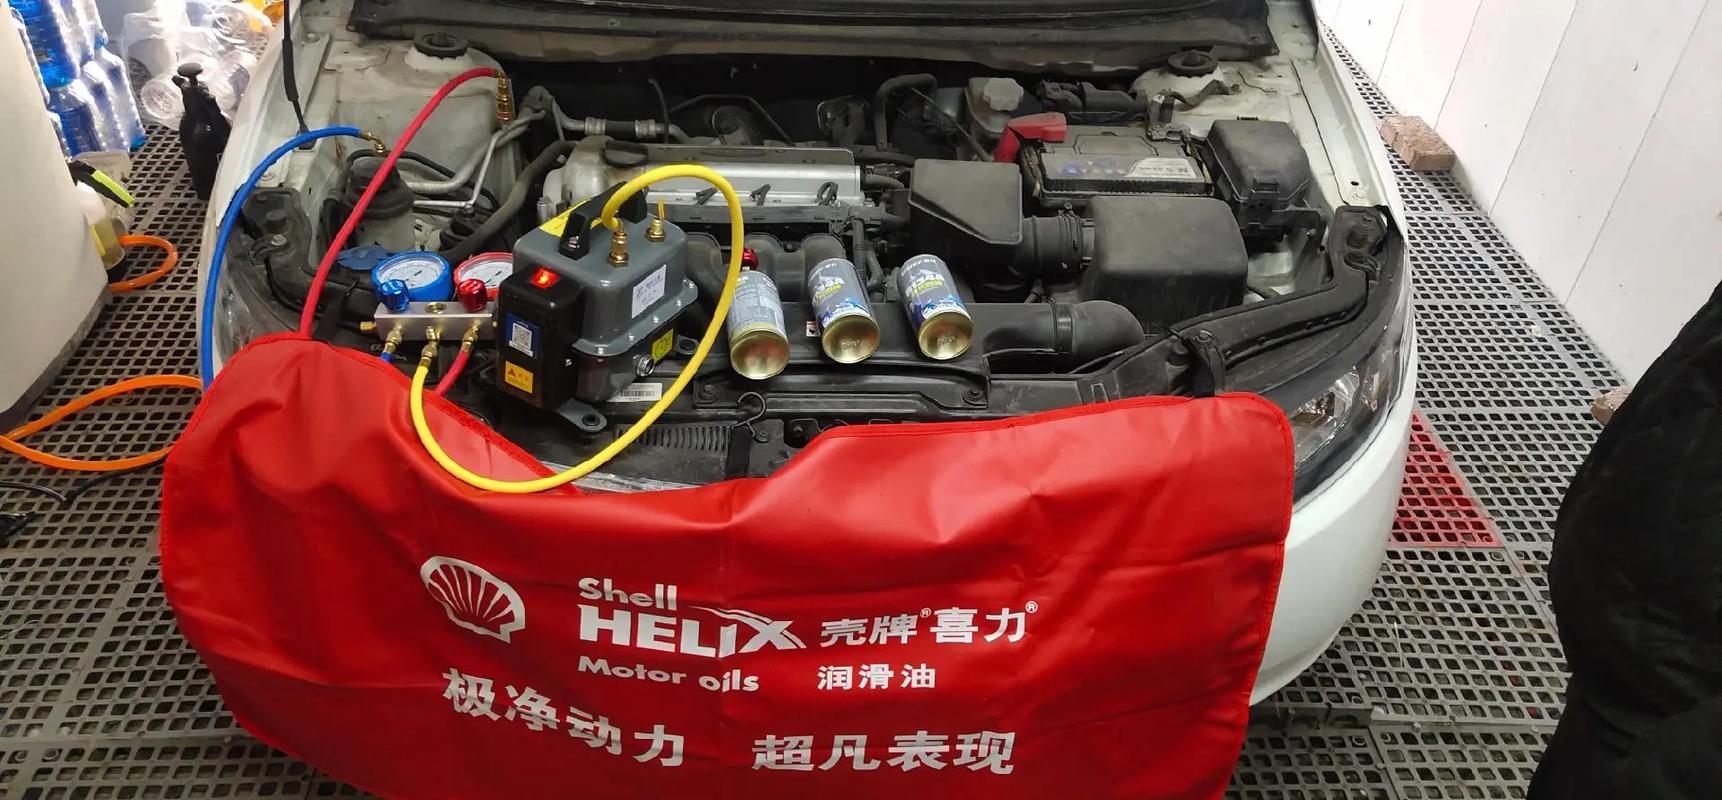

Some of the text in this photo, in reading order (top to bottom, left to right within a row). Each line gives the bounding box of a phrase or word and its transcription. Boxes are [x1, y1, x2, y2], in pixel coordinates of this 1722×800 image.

[578, 577, 678, 611] Shell
[578, 655, 760, 693] Motor oils
[817, 662, 937, 691] 润滑油
[441, 666, 1017, 776] 极净动力 超凡表现
